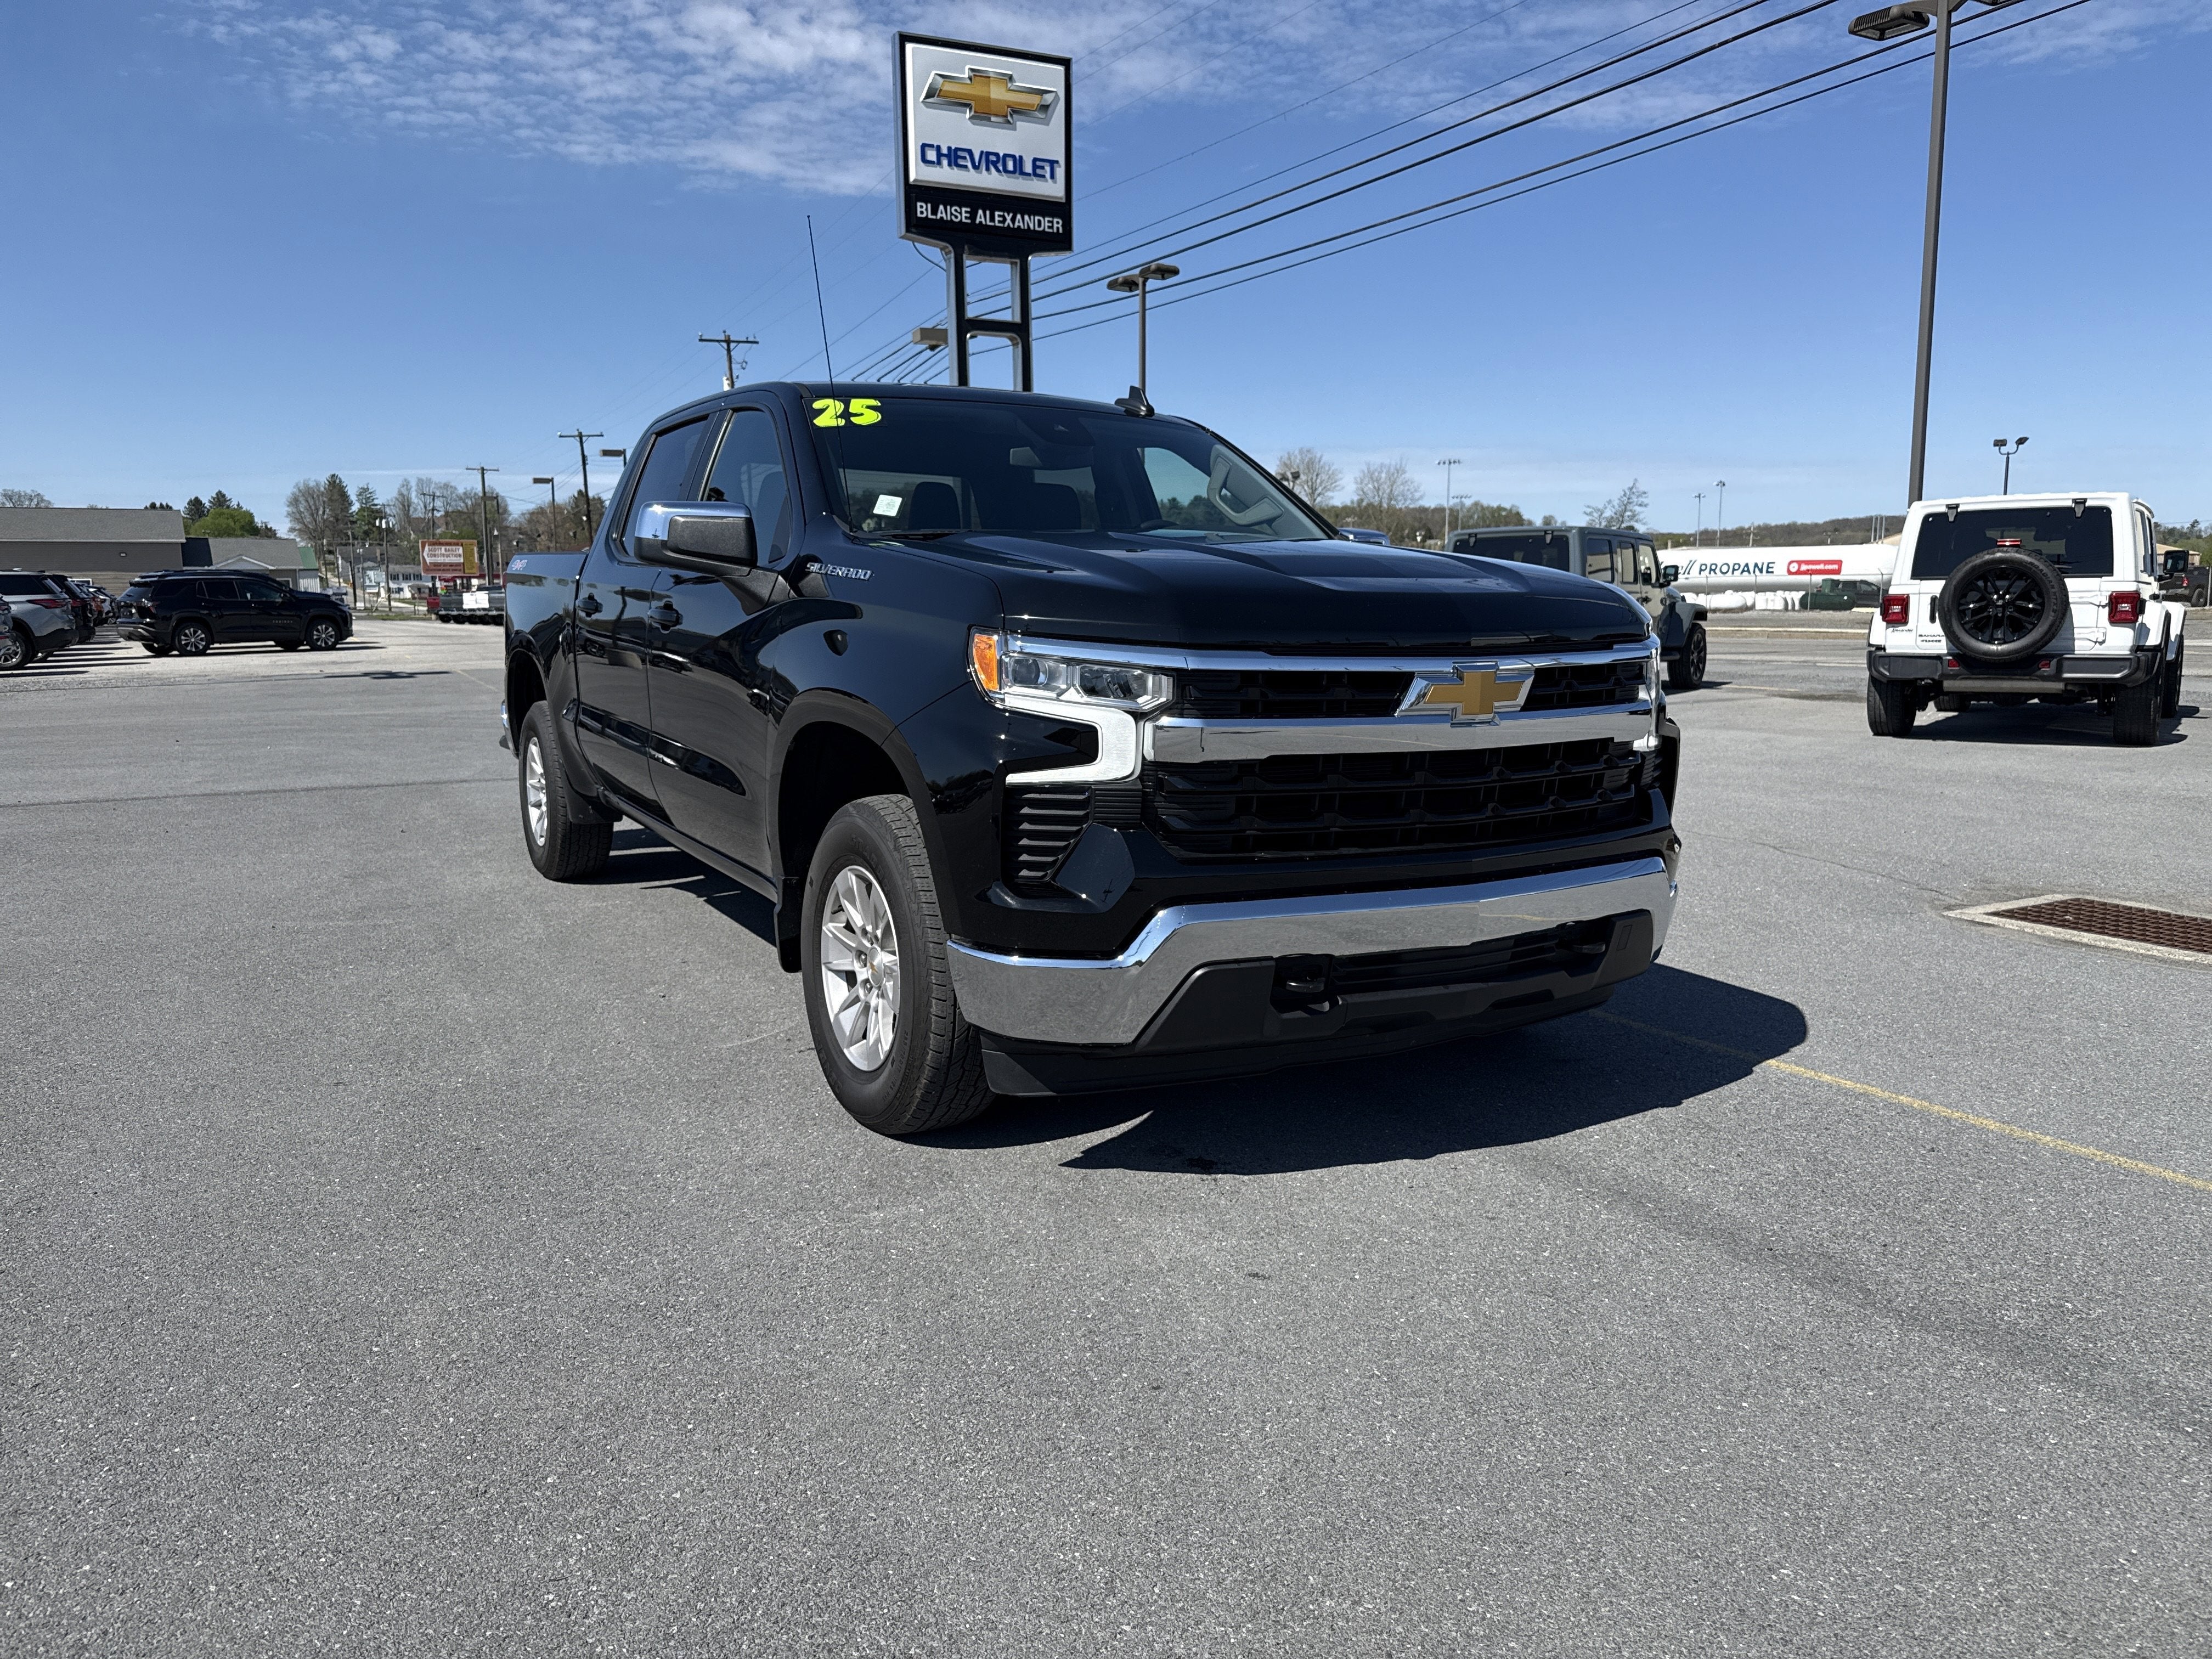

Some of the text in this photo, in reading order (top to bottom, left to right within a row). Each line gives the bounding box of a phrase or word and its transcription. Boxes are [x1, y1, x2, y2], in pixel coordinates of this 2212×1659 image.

[920, 142, 1059, 180] CHEVROLET
[916, 201, 1063, 234] BLAISE ALEXANDER
[812, 399, 882, 427] 25
[805, 562, 872, 580] SILVERADO
[1699, 561, 1775, 575] PROPANE
